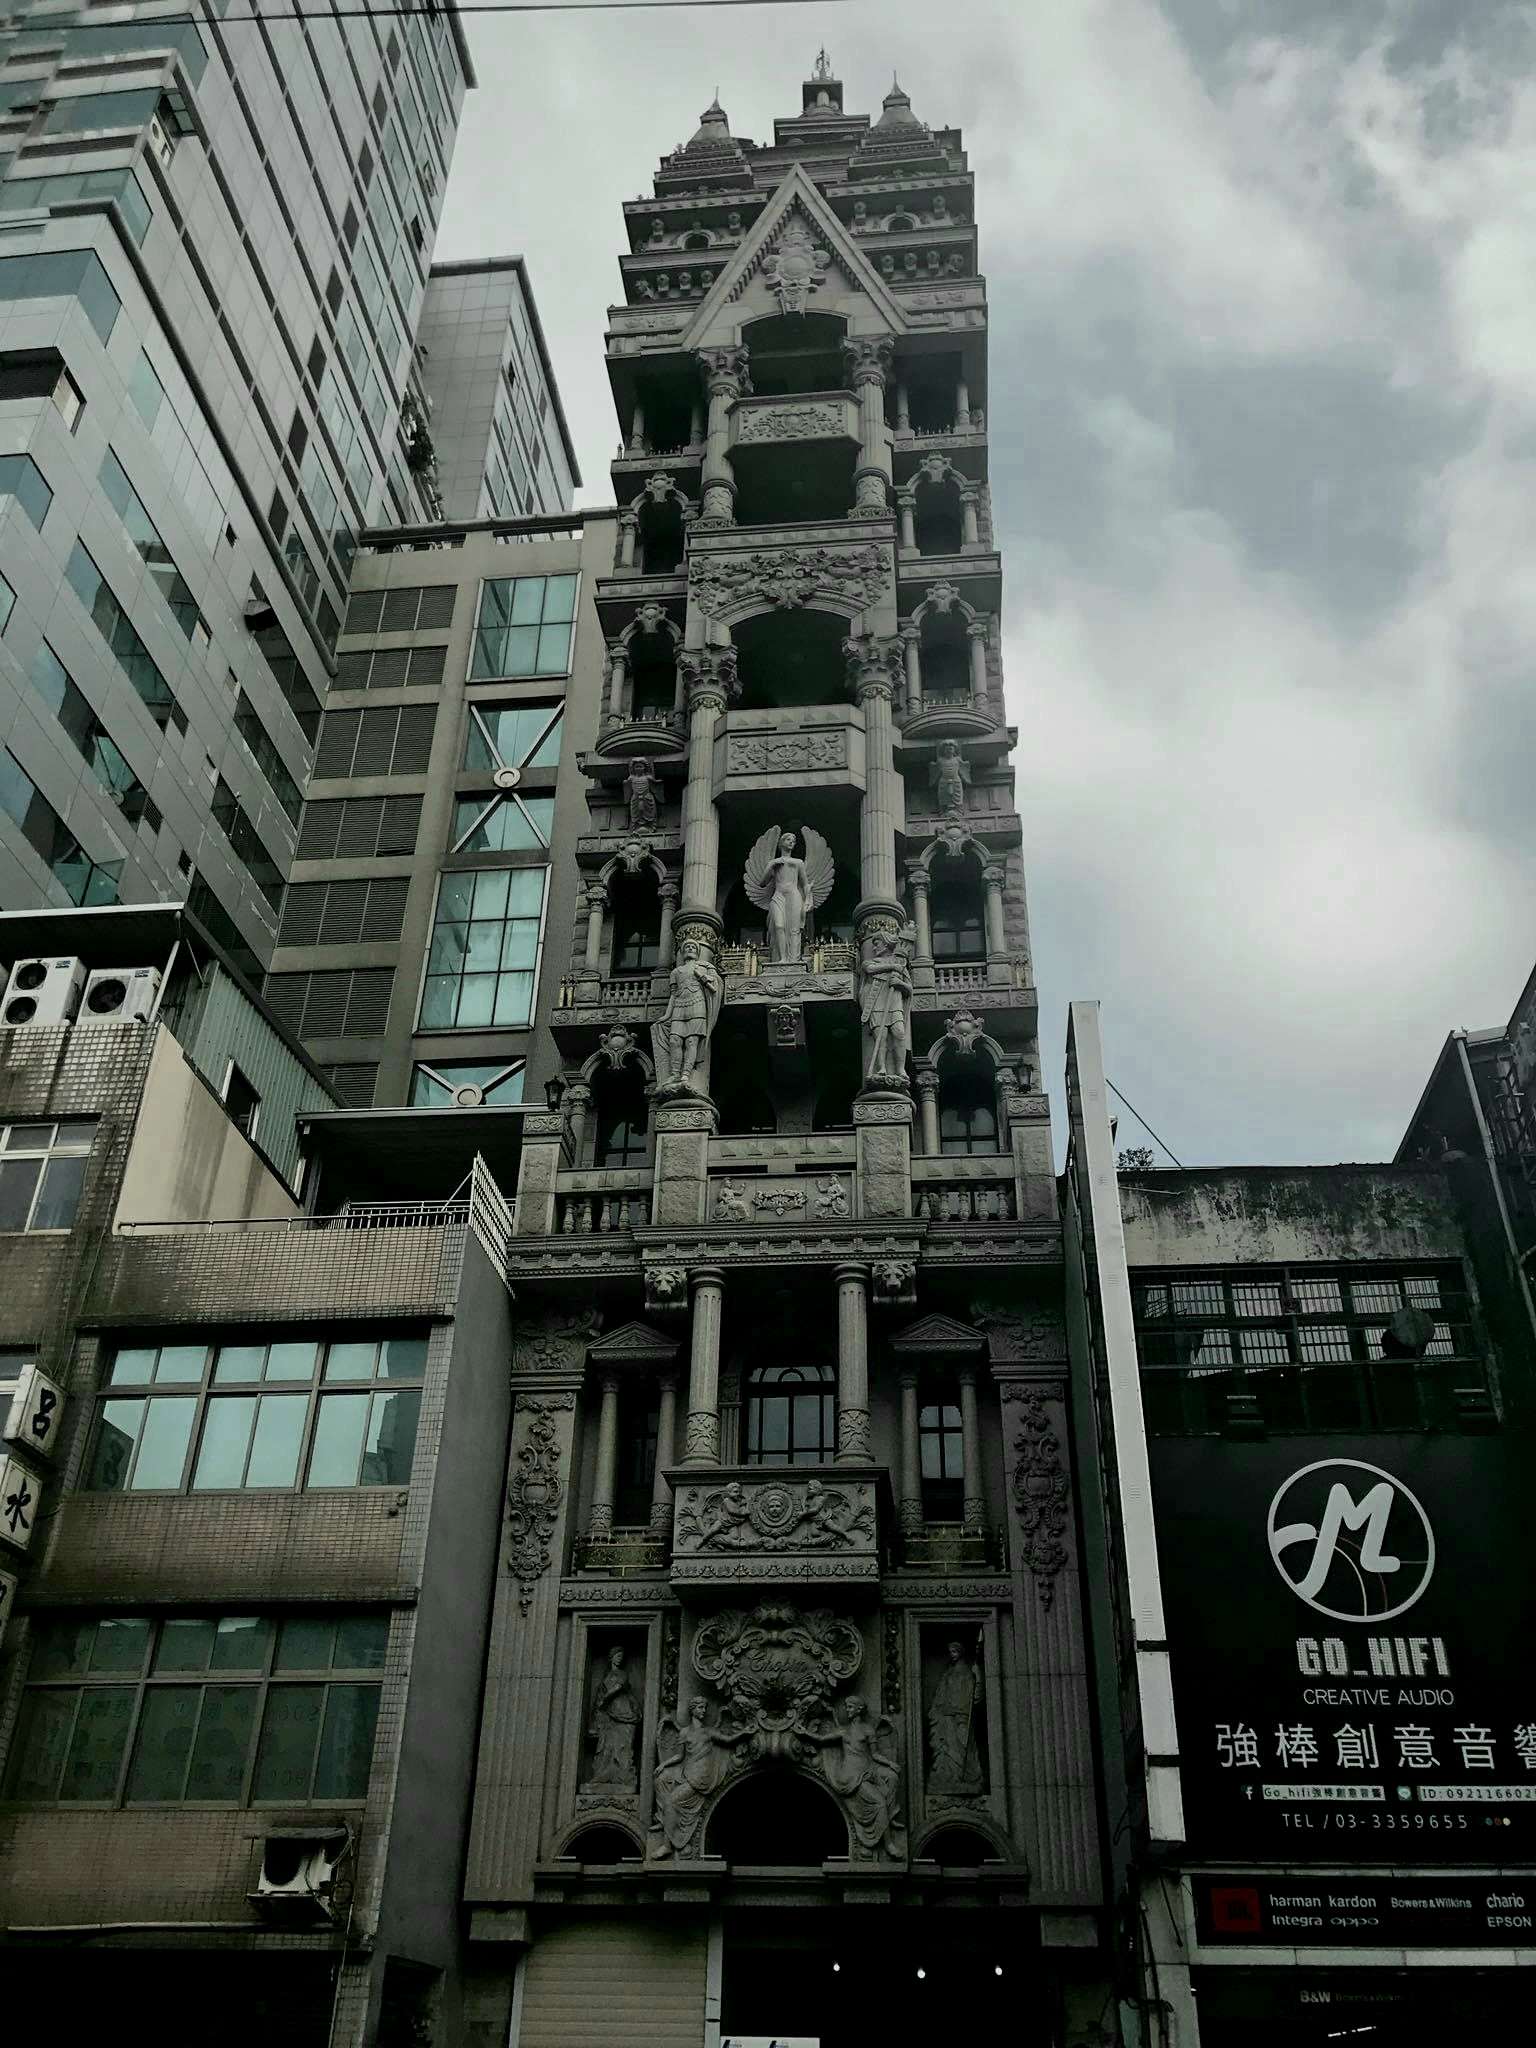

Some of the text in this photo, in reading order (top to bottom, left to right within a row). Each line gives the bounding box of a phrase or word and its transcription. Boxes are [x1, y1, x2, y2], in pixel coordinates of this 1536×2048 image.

[1303, 1688, 1455, 1706] CREATIVE AUDIO
[1269, 1894, 1377, 1908] harman kardon
[1486, 1892, 1525, 1909] chario
[1272, 1914, 1323, 1927] Integra
[1487, 1916, 1532, 1928] EPSON
